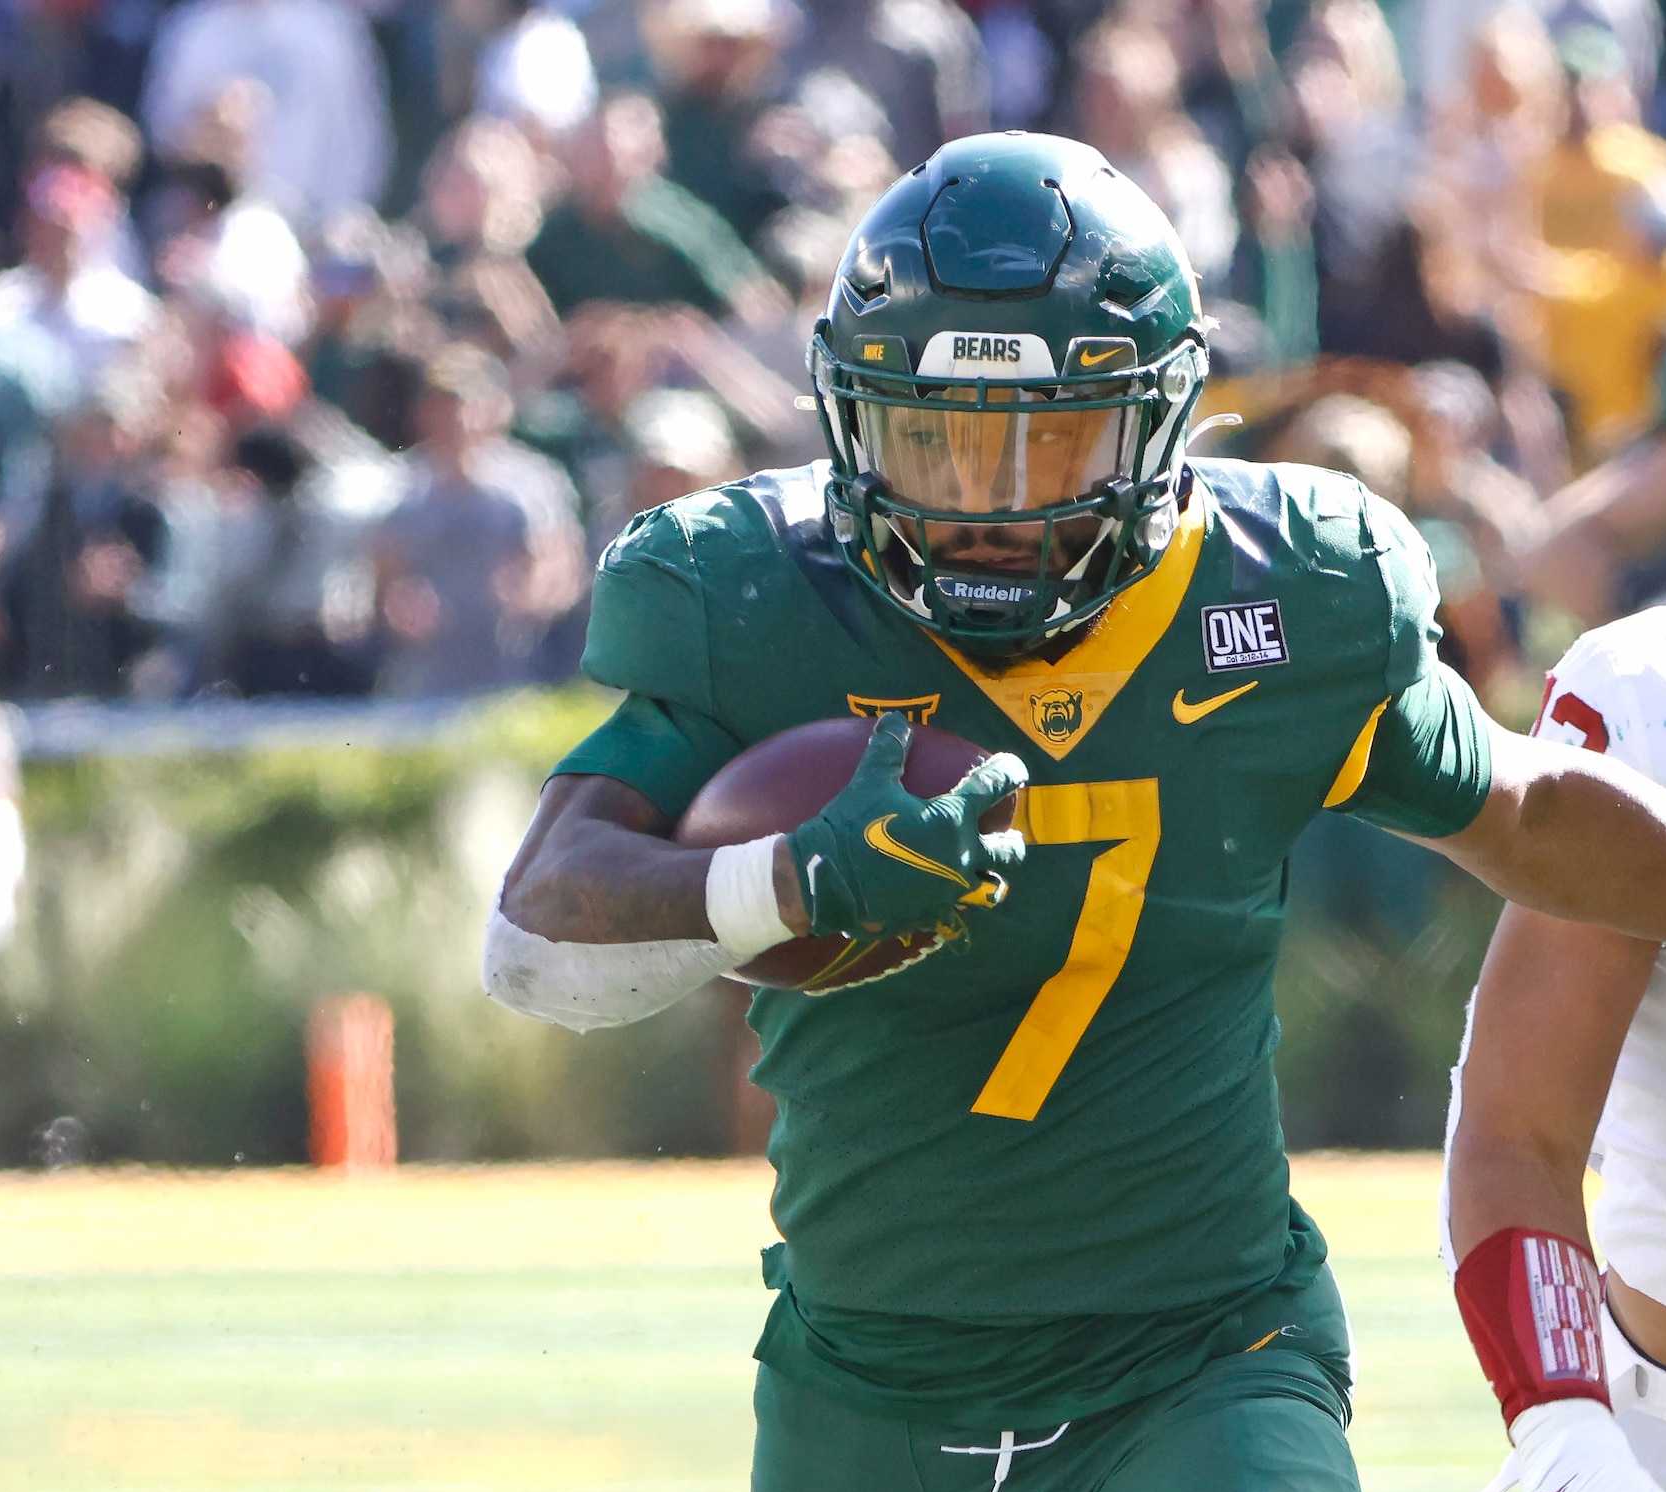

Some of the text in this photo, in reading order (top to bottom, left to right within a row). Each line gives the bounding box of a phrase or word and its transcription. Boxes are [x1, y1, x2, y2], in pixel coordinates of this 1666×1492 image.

[863, 344, 885, 361] NIKE
[952, 336, 1021, 362] BEARS
[953, 582, 1022, 602] Riddell
[1209, 606, 1280, 655] ONE
[969, 777, 1162, 1122] 7
